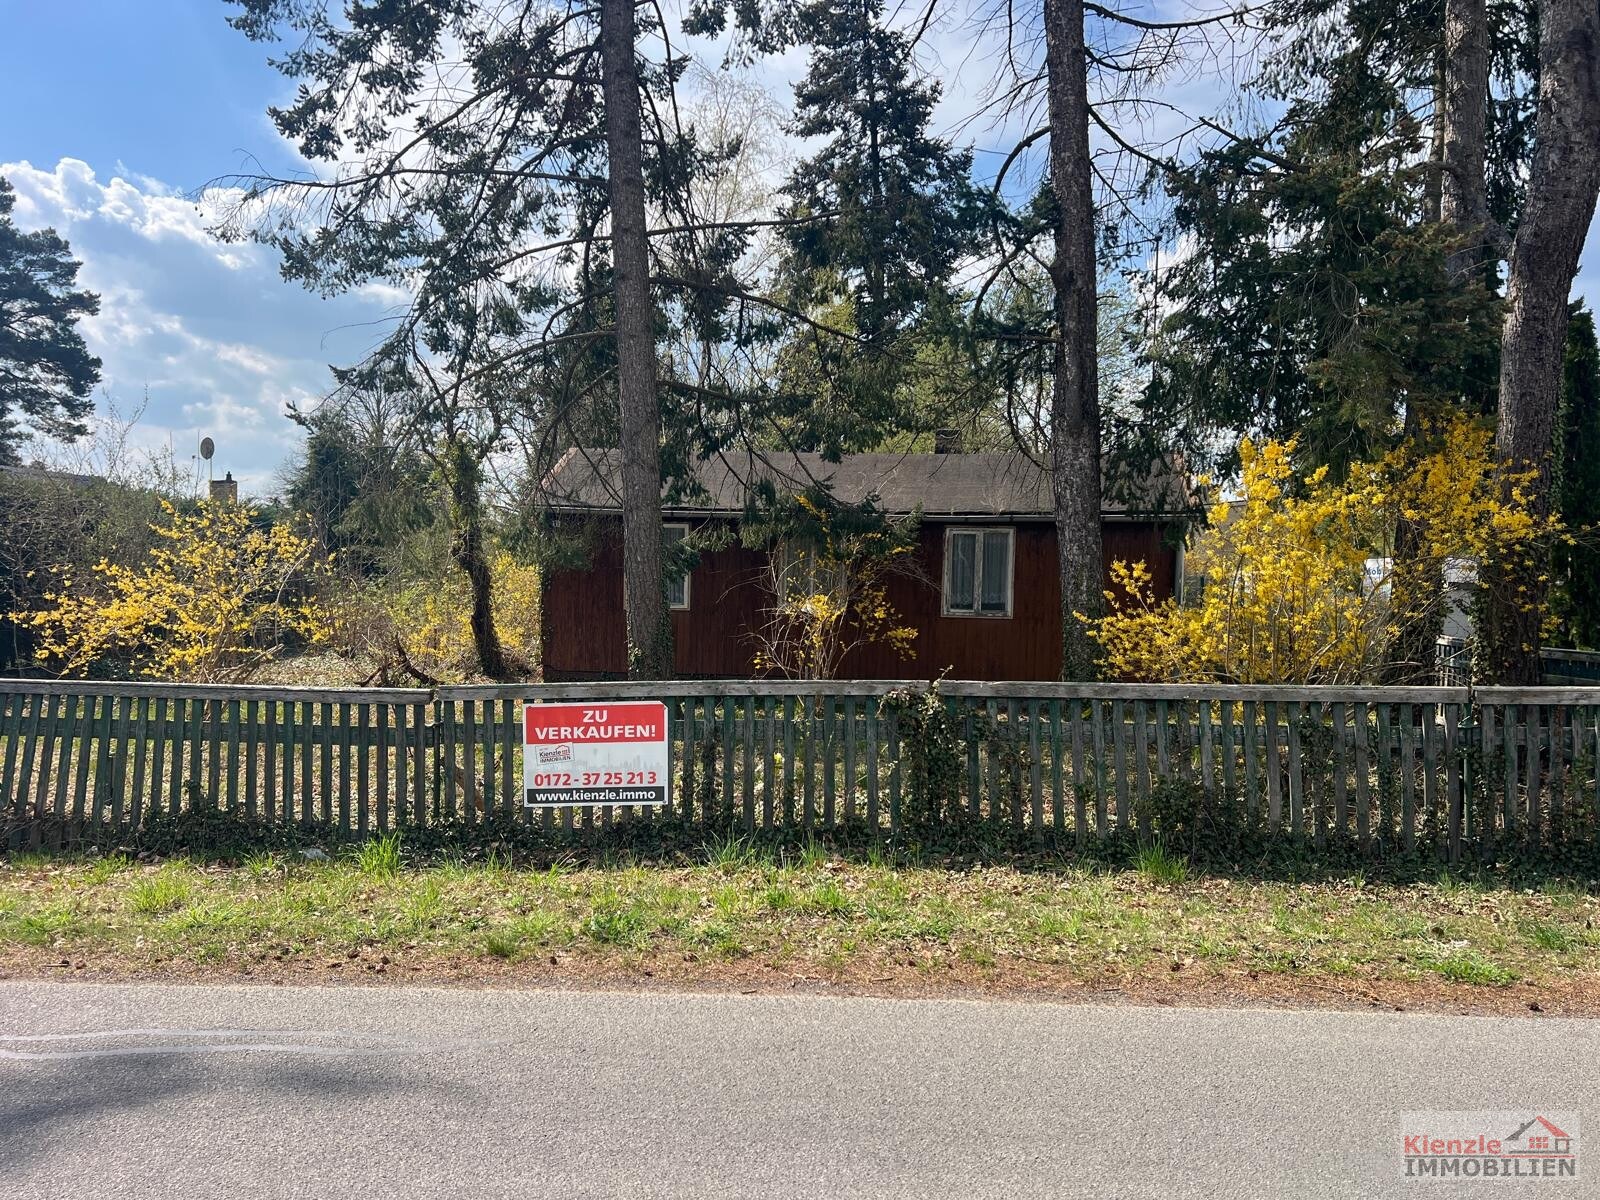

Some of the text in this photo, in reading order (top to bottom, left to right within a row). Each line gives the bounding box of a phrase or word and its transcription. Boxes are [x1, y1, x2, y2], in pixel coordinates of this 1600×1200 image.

[583, 710, 608, 723] ZU
[535, 725, 656, 740] VERKAUFEN!
[534, 773, 571, 787] 0172
[535, 789, 656, 801] www.kienzle.immo
